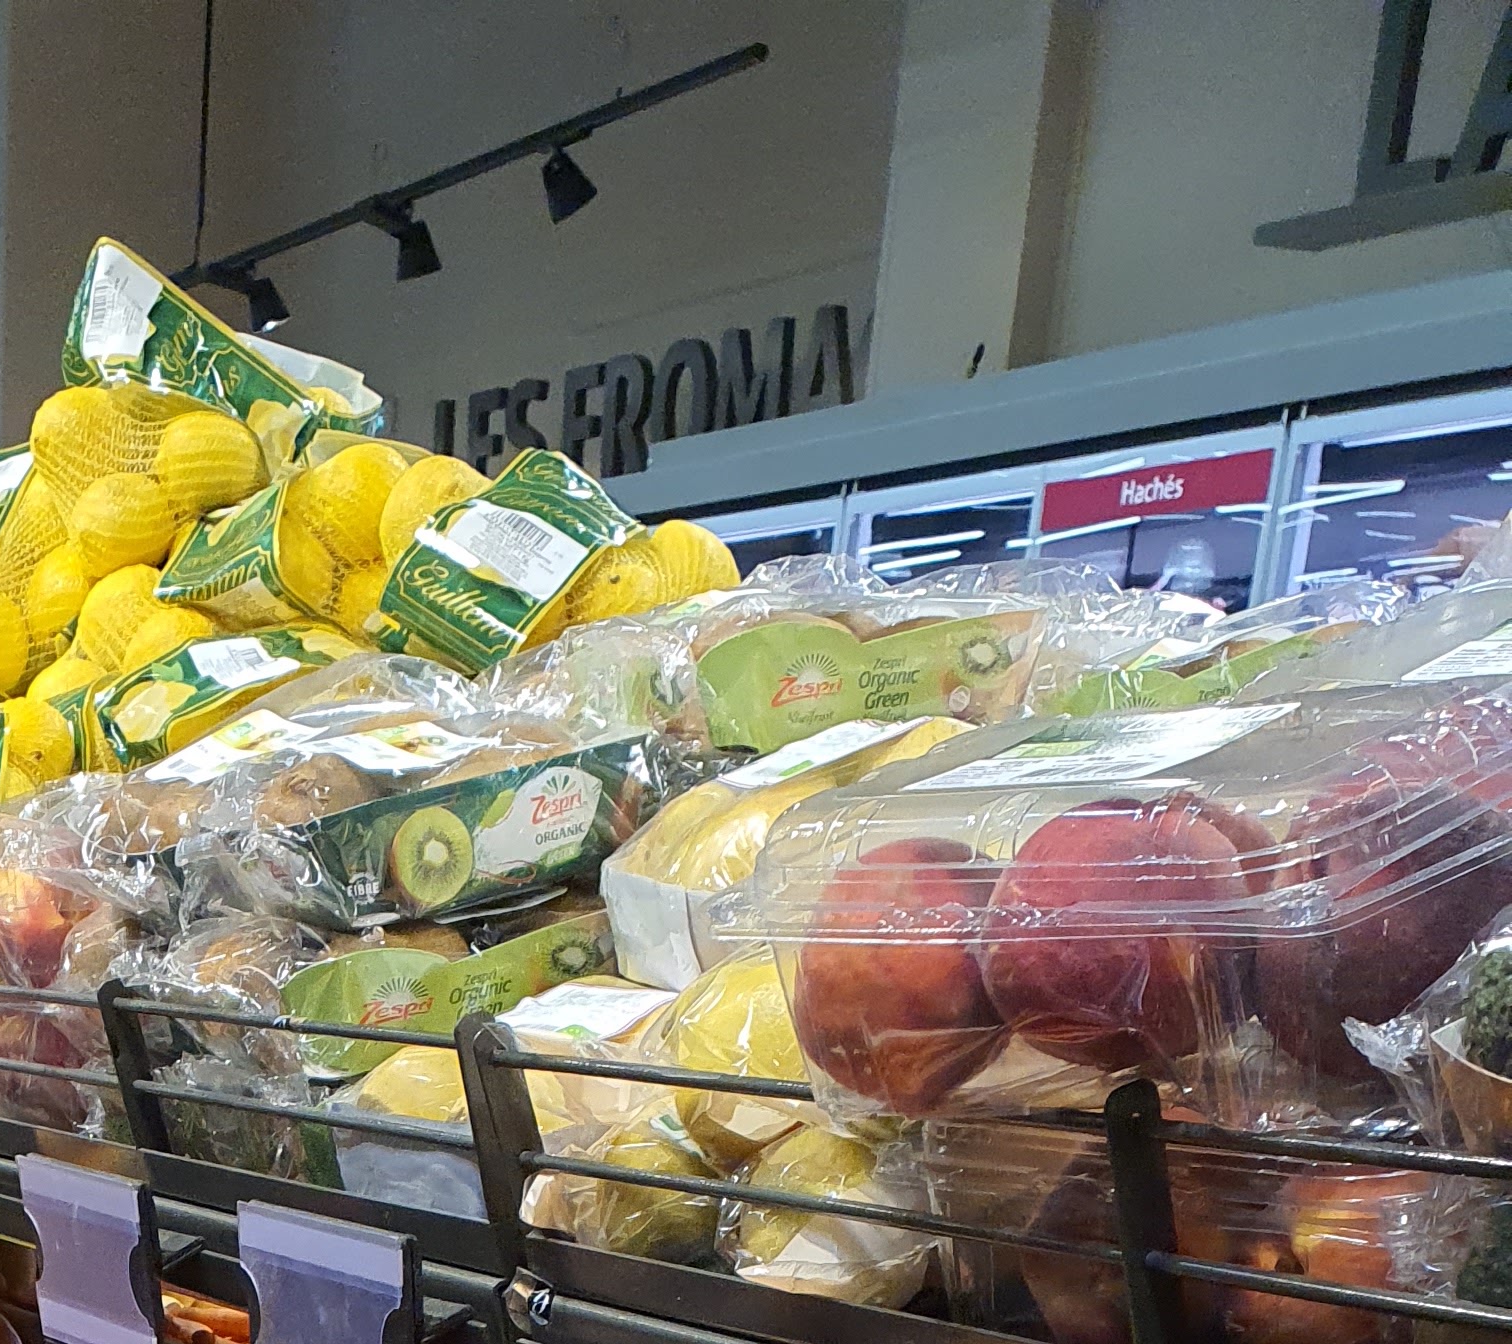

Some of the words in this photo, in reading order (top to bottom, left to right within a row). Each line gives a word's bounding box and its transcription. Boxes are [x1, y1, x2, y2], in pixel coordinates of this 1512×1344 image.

[563, 304, 875, 479] FROMA
[1120, 473, 1185, 507] Hachés
[770, 675, 843, 708] Zespri
[858, 668, 921, 694] Organic
[864, 691, 910, 710] Green
[530, 788, 582, 825] Zespri
[535, 821, 588, 846] ORGANIC
[346, 879, 380, 898] FIBRE
[449, 976, 512, 1007] Organic
[359, 996, 435, 1026] Zespri
